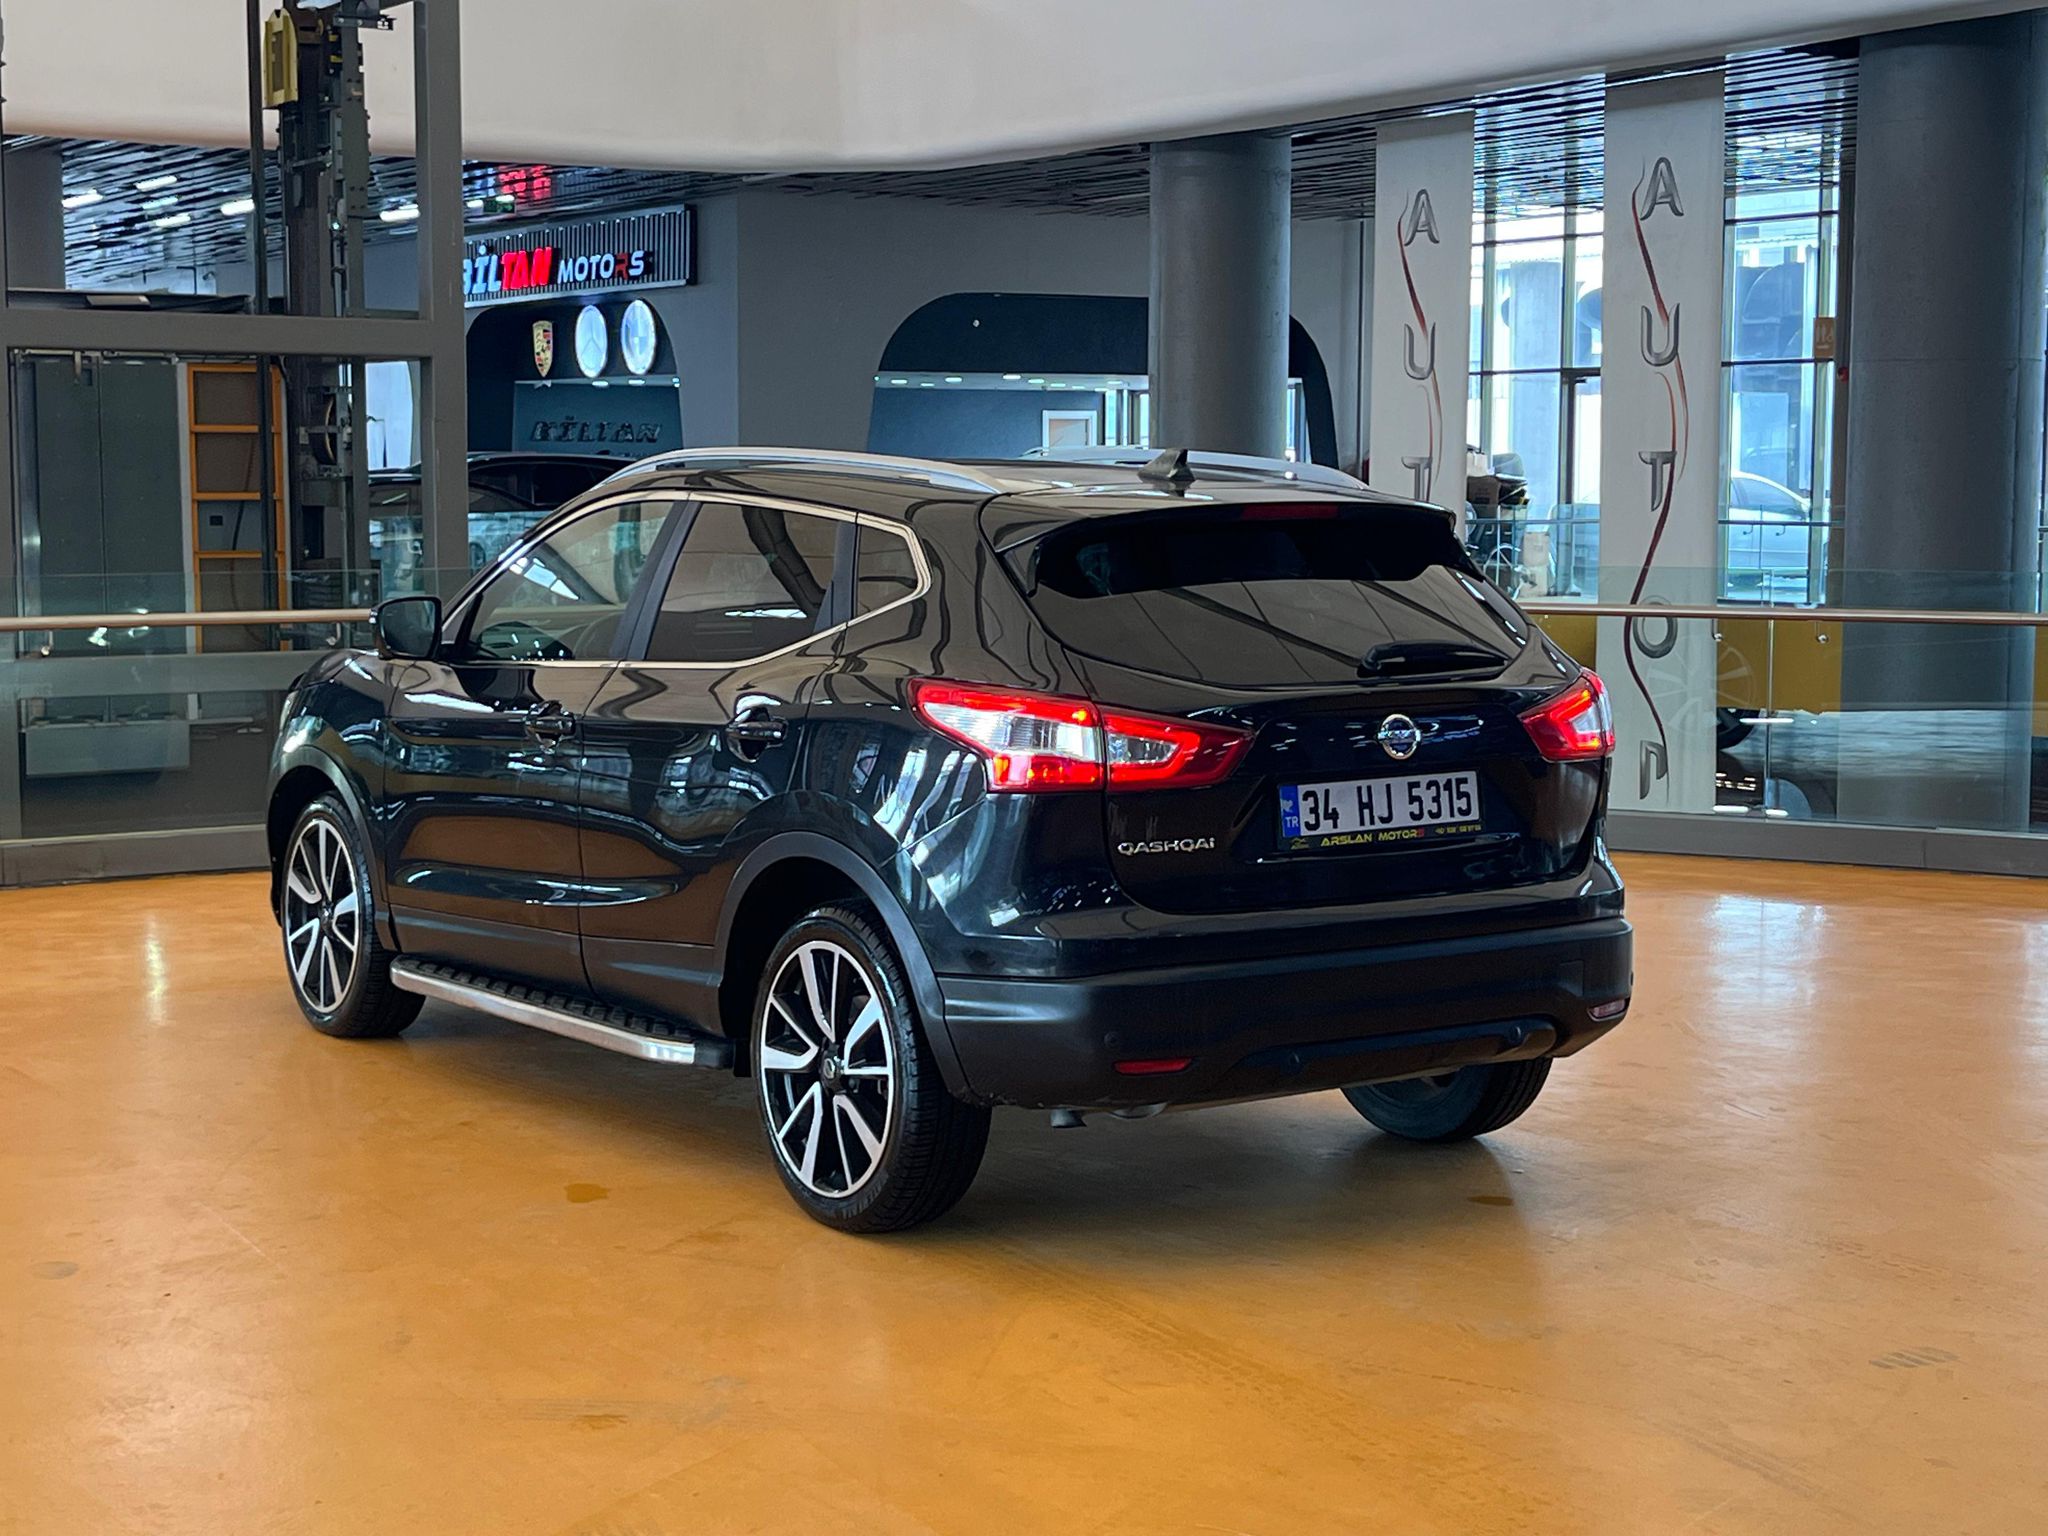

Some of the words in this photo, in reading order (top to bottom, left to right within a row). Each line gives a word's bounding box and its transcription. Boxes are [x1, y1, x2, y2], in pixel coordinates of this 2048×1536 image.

[557, 250, 645, 285] MOTORS
[1302, 788, 1340, 832] 34
[1356, 783, 1394, 827] HJ
[1407, 777, 1472, 822] 5315
[1285, 815, 1299, 828] TR
[1320, 833, 1373, 847] ARSLAN
[1378, 828, 1425, 842] MOTORS
